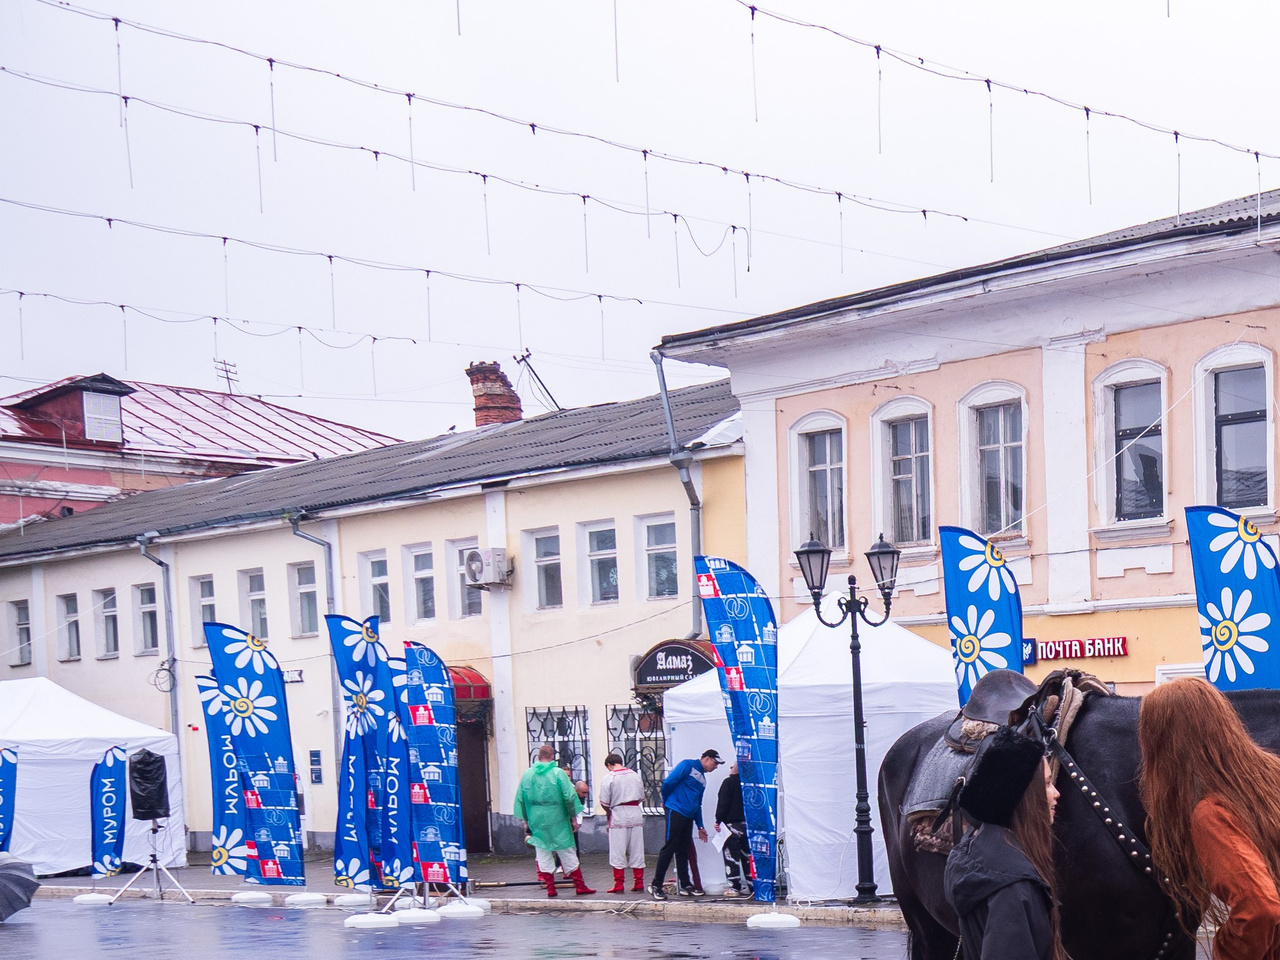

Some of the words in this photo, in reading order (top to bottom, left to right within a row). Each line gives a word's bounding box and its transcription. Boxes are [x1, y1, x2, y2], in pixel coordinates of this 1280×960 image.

[1038, 641, 1082, 659] ПОЧТА
[1084, 638, 1125, 657] БАНК
[656, 652, 692, 674] Алмаз
[101, 778, 117, 844] МУРОМ
